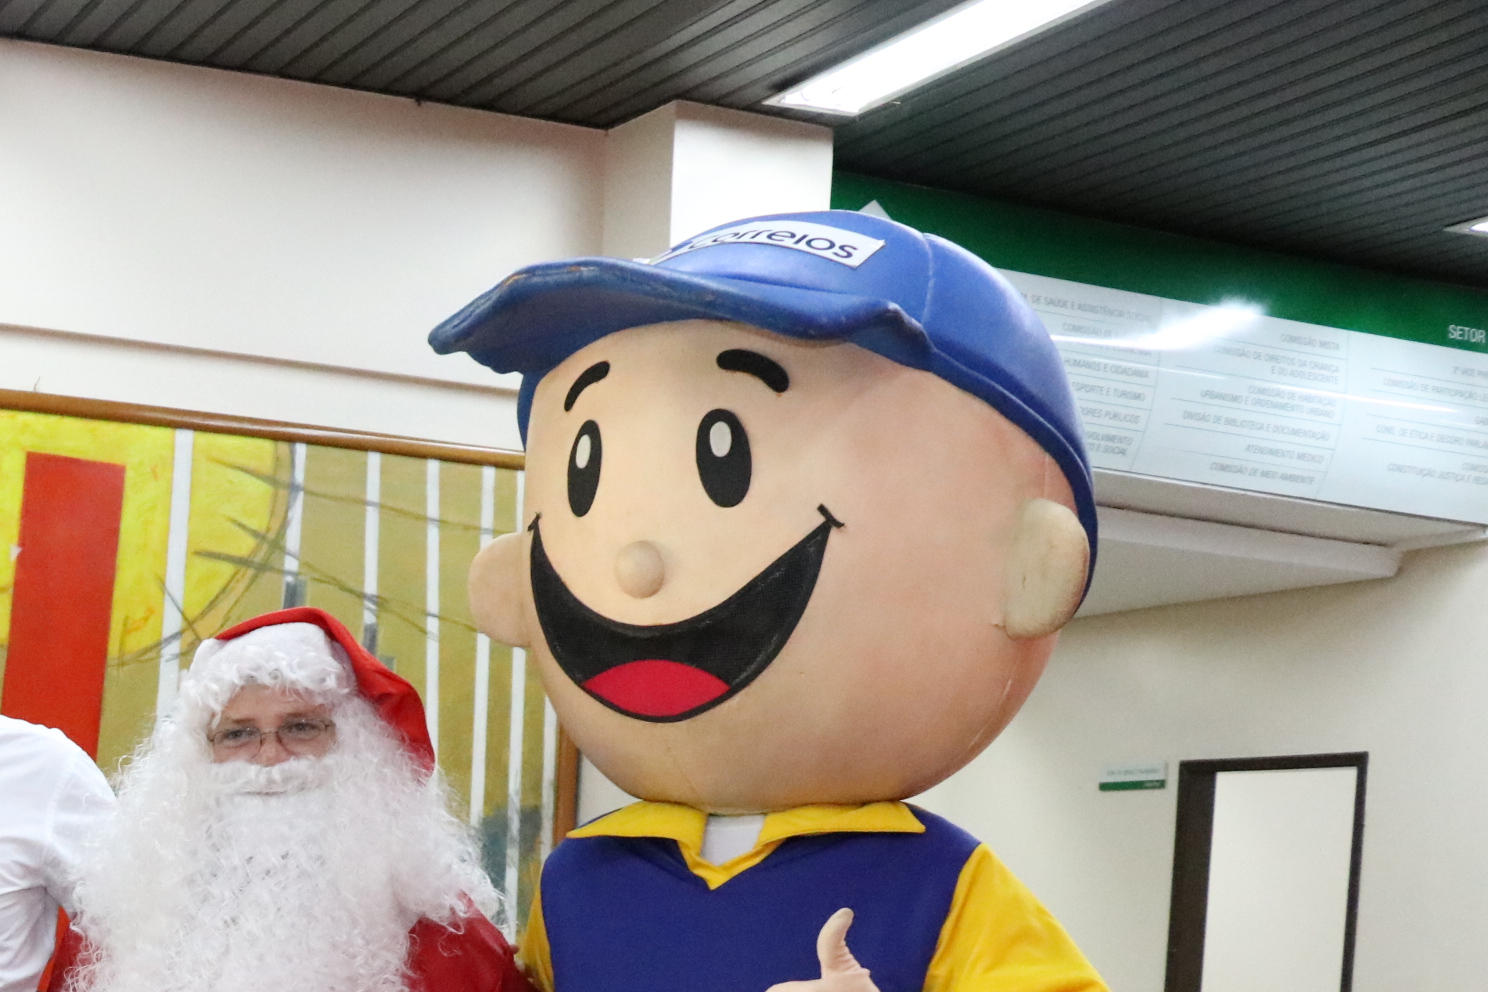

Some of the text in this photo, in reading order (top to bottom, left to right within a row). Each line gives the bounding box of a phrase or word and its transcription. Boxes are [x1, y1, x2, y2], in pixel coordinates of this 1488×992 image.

[1031, 294, 1042, 305] DE
[1070, 300, 1076, 310] E
[1280, 333, 1341, 351] COMISSÃO MISTA
[1448, 324, 1486, 344] SETOR
[1253, 351, 1263, 361] DE
[1264, 353, 1296, 366] DIREITOS
[1104, 363, 1109, 373] E
[1110, 364, 1150, 379] CIDADANIA
[1271, 365, 1276, 374] E
[1289, 369, 1339, 384] ADOLESCENTE
[1106, 387, 1111, 397] E
[1112, 388, 1147, 402] TURISMO
[1287, 391, 1297, 401] DE
[1420, 384, 1430, 393] DE
[1200, 389, 1243, 404] URBANISMO
[1244, 396, 1250, 405] E
[1182, 410, 1331, 442] DIVISÃO DE BIBLIOTECA E DOCUMENTAÇÃO
[1399, 427, 1409, 437] DE
[1430, 432, 1436, 441] E
[1244, 444, 1296, 460] ATENDIMENTO
[1249, 467, 1260, 477] DE
[1260, 470, 1279, 480] MEIO
[1279, 472, 1316, 486] AMBIENTE
